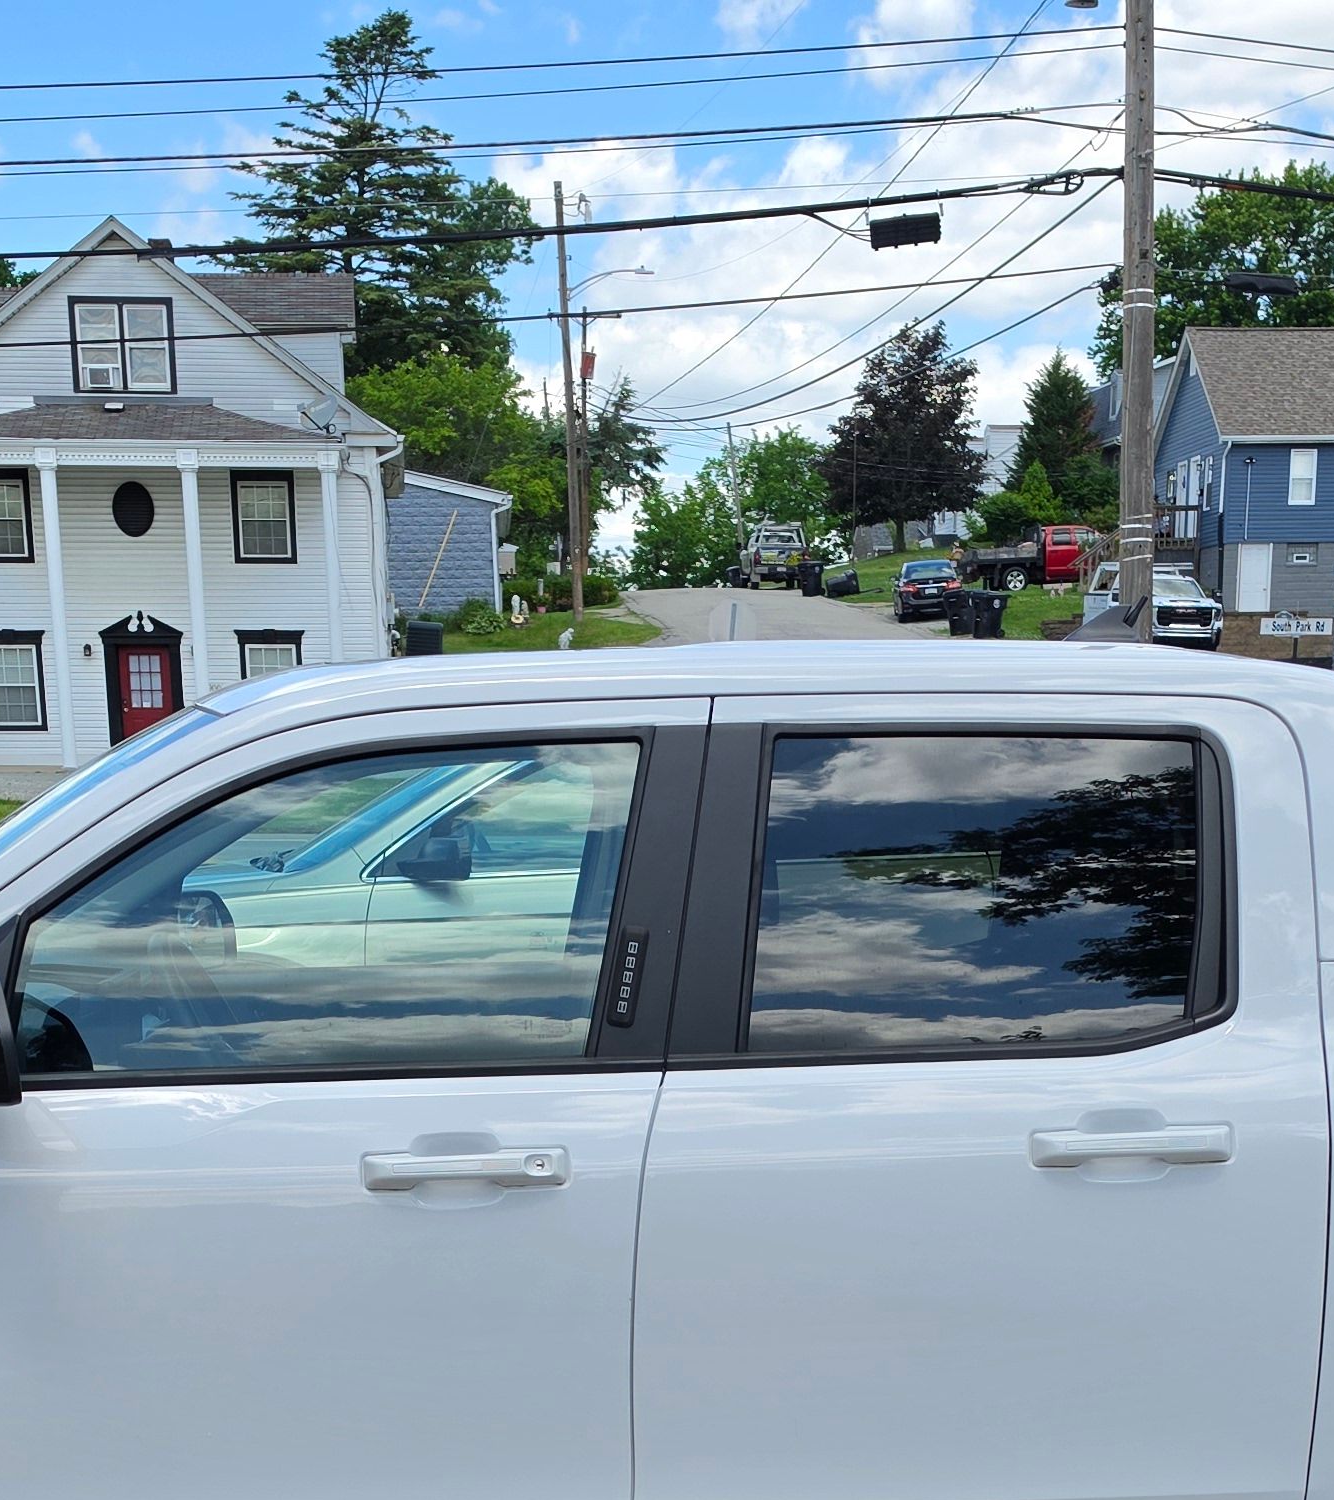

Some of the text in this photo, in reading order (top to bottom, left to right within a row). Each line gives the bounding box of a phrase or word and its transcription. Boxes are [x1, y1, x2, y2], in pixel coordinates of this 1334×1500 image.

[1271, 620, 1325, 632] South Park Rd
